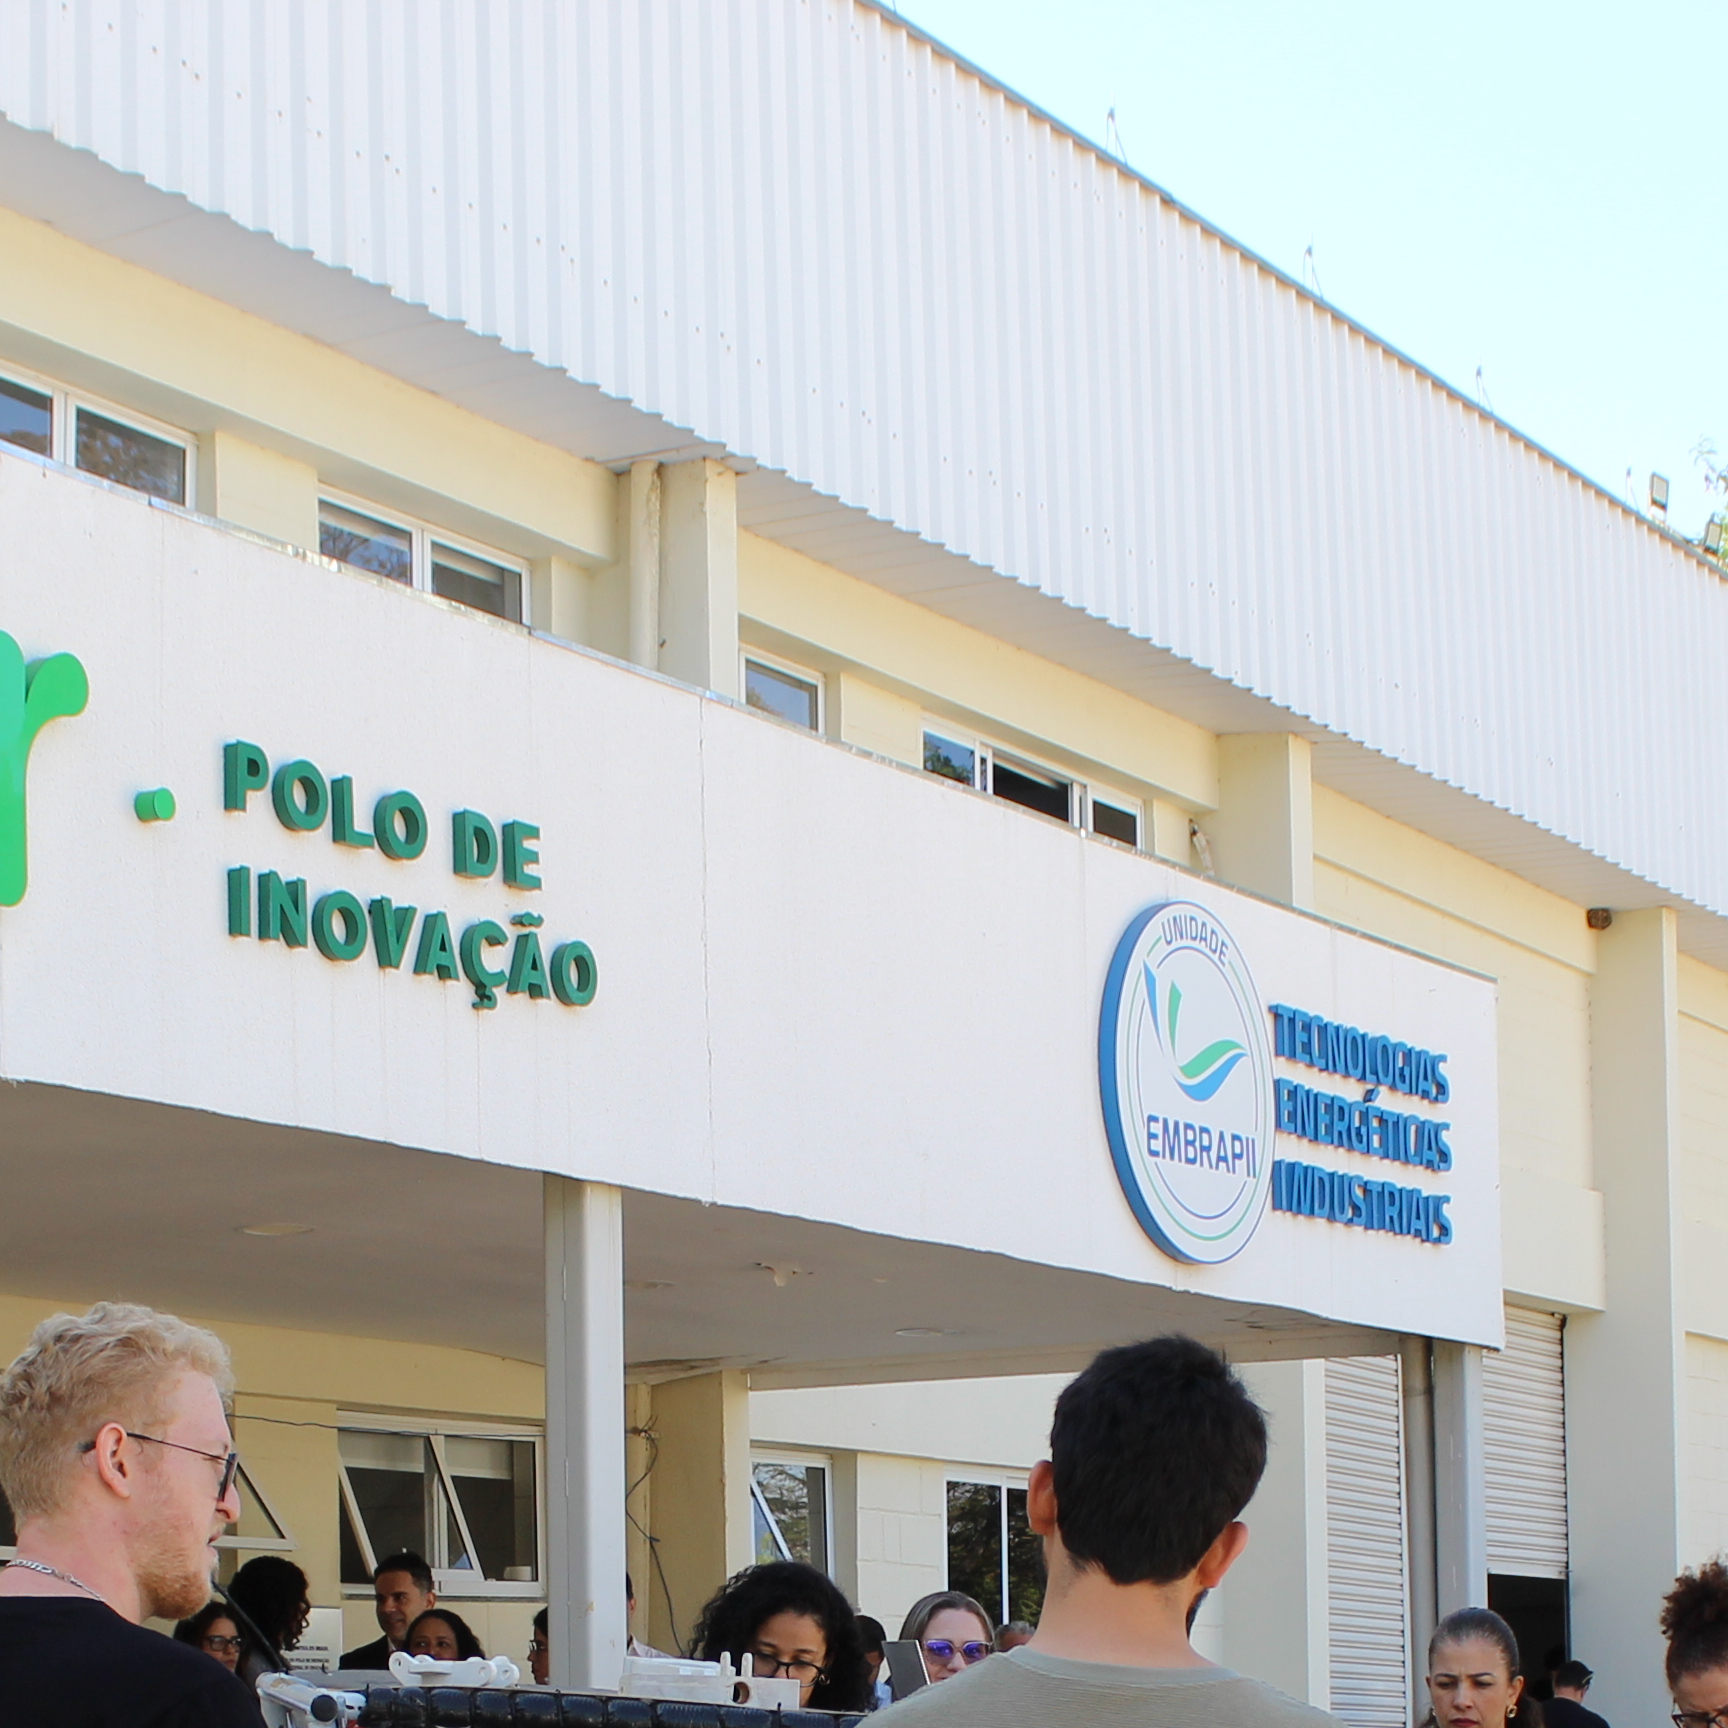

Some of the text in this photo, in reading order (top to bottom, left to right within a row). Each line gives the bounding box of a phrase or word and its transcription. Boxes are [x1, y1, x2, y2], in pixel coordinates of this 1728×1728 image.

[224, 738, 543, 890] POLO DE
[227, 865, 598, 1010] INOVAÇÃO
[1160, 914, 1230, 967] UNIDADE
[1269, 1003, 1451, 1103] TECNOLOGIAS
[1146, 1113, 1257, 1179] EMBRAPII
[1273, 1078, 1453, 1172] ENERGÉTICAS
[1272, 1159, 1454, 1245] INDUSTRIAIS
